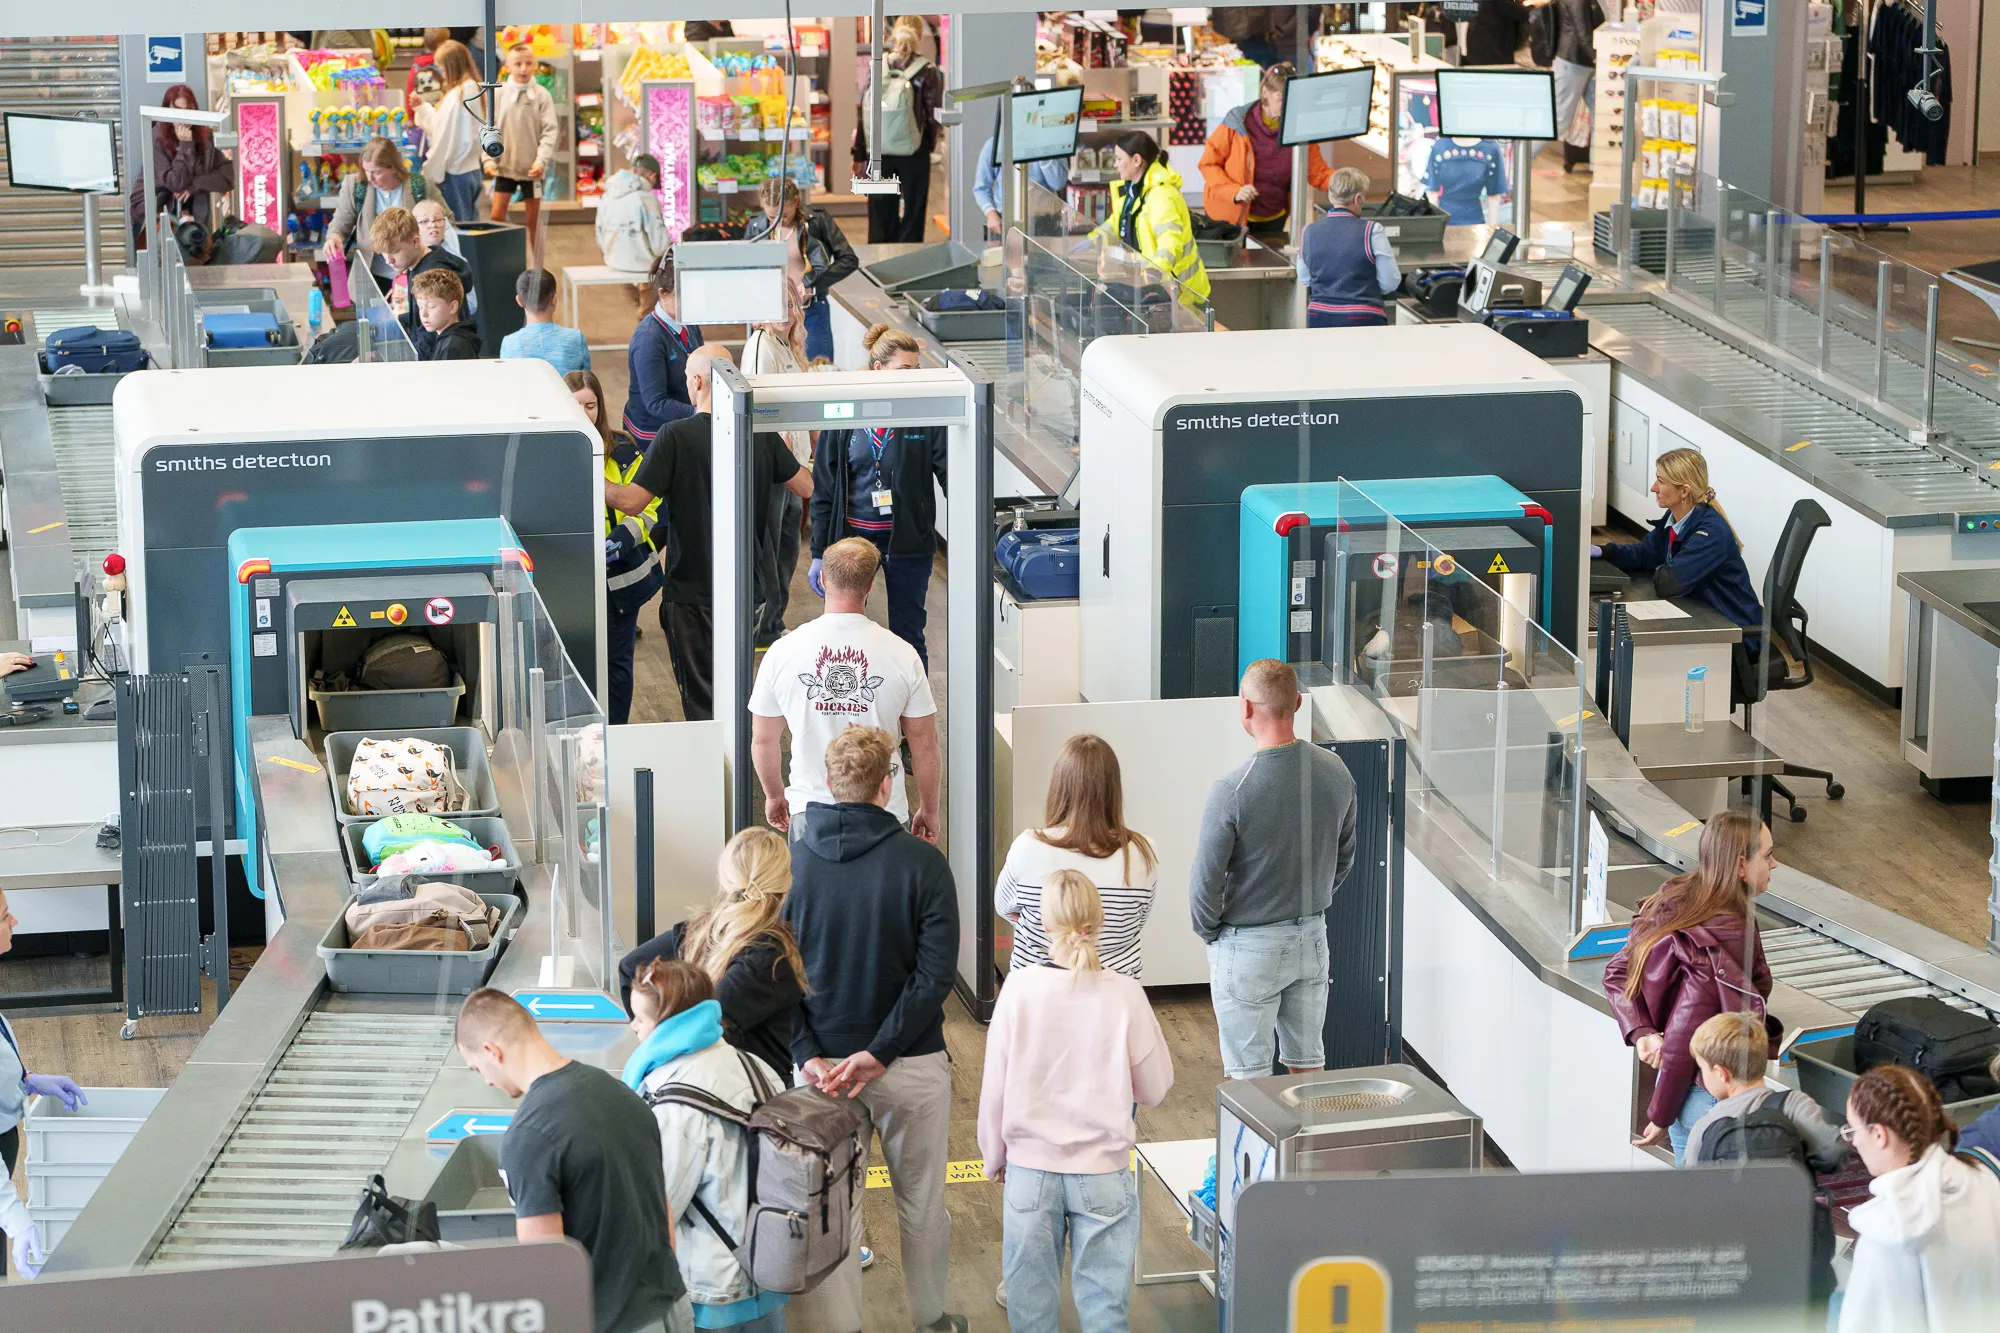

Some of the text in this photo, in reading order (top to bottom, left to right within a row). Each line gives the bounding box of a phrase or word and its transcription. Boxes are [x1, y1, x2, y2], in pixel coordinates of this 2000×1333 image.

[254, 174, 267, 225] SWEETS
[663, 142, 676, 226] SALDUMYNAI
[1176, 411, 1339, 430] smiths detection
[156, 452, 331, 472] smiths detection
[815, 701, 869, 713] DICKIES
[351, 1291, 545, 1333] Patikra
